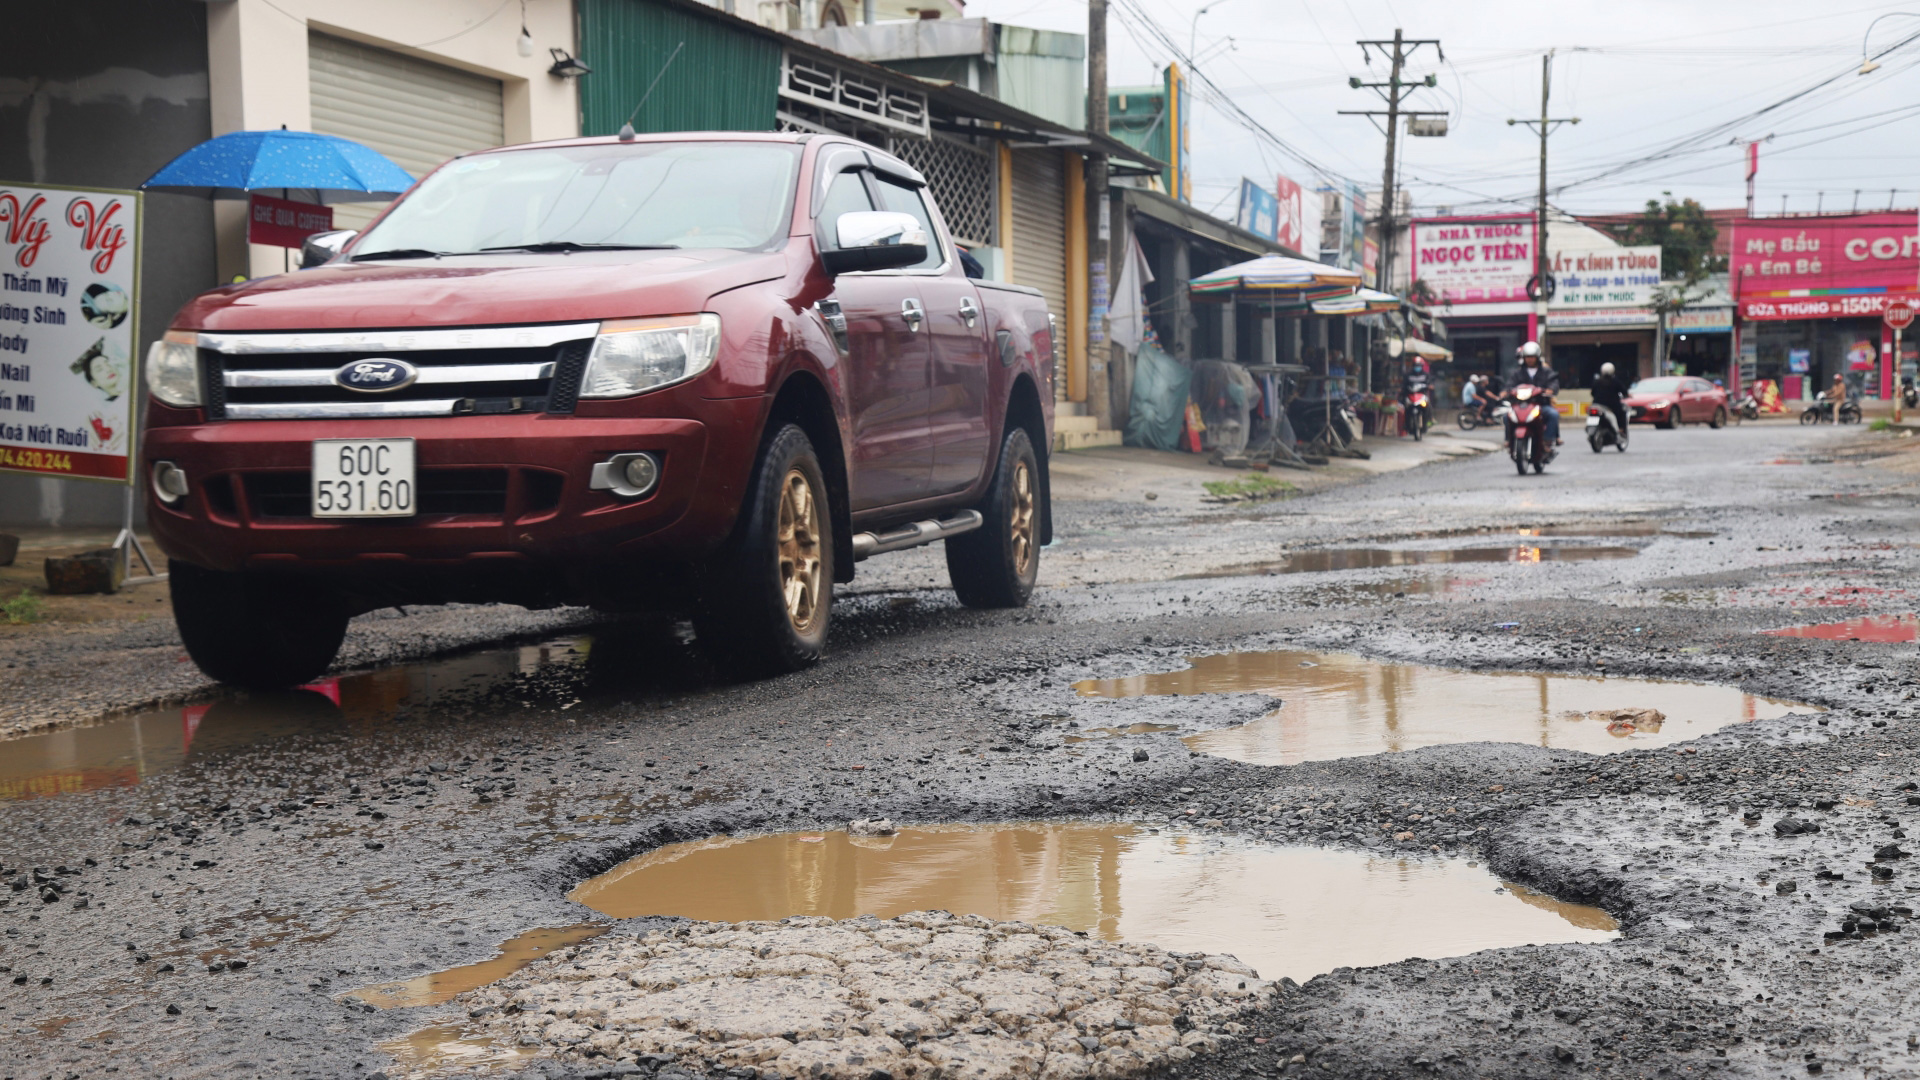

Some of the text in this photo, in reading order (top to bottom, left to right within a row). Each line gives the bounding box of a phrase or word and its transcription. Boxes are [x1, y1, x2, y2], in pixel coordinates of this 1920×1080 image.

[276, 208, 295, 227] QUA
[297, 212, 331, 232] COFFEE
[66, 196, 127, 274] Vy
[1421, 244, 1475, 266] NGỌC
[1746, 238, 1776, 258] Mẹ
[1577, 252, 1614, 271] KÍNH
[1760, 260, 1791, 275] Em
[1796, 256, 1822, 275] Bé
[3, 271, 68, 297] Thẩm Mỹ
[33, 306, 66, 325] Sinh
[1888, 309, 1912, 321] STOP
[1, 362, 30, 382] Nail
[349, 363, 397, 383] Ford
[28, 424, 52, 444] Nốt
[339, 445, 390, 476] 60C
[317, 479, 411, 511] 531.60
